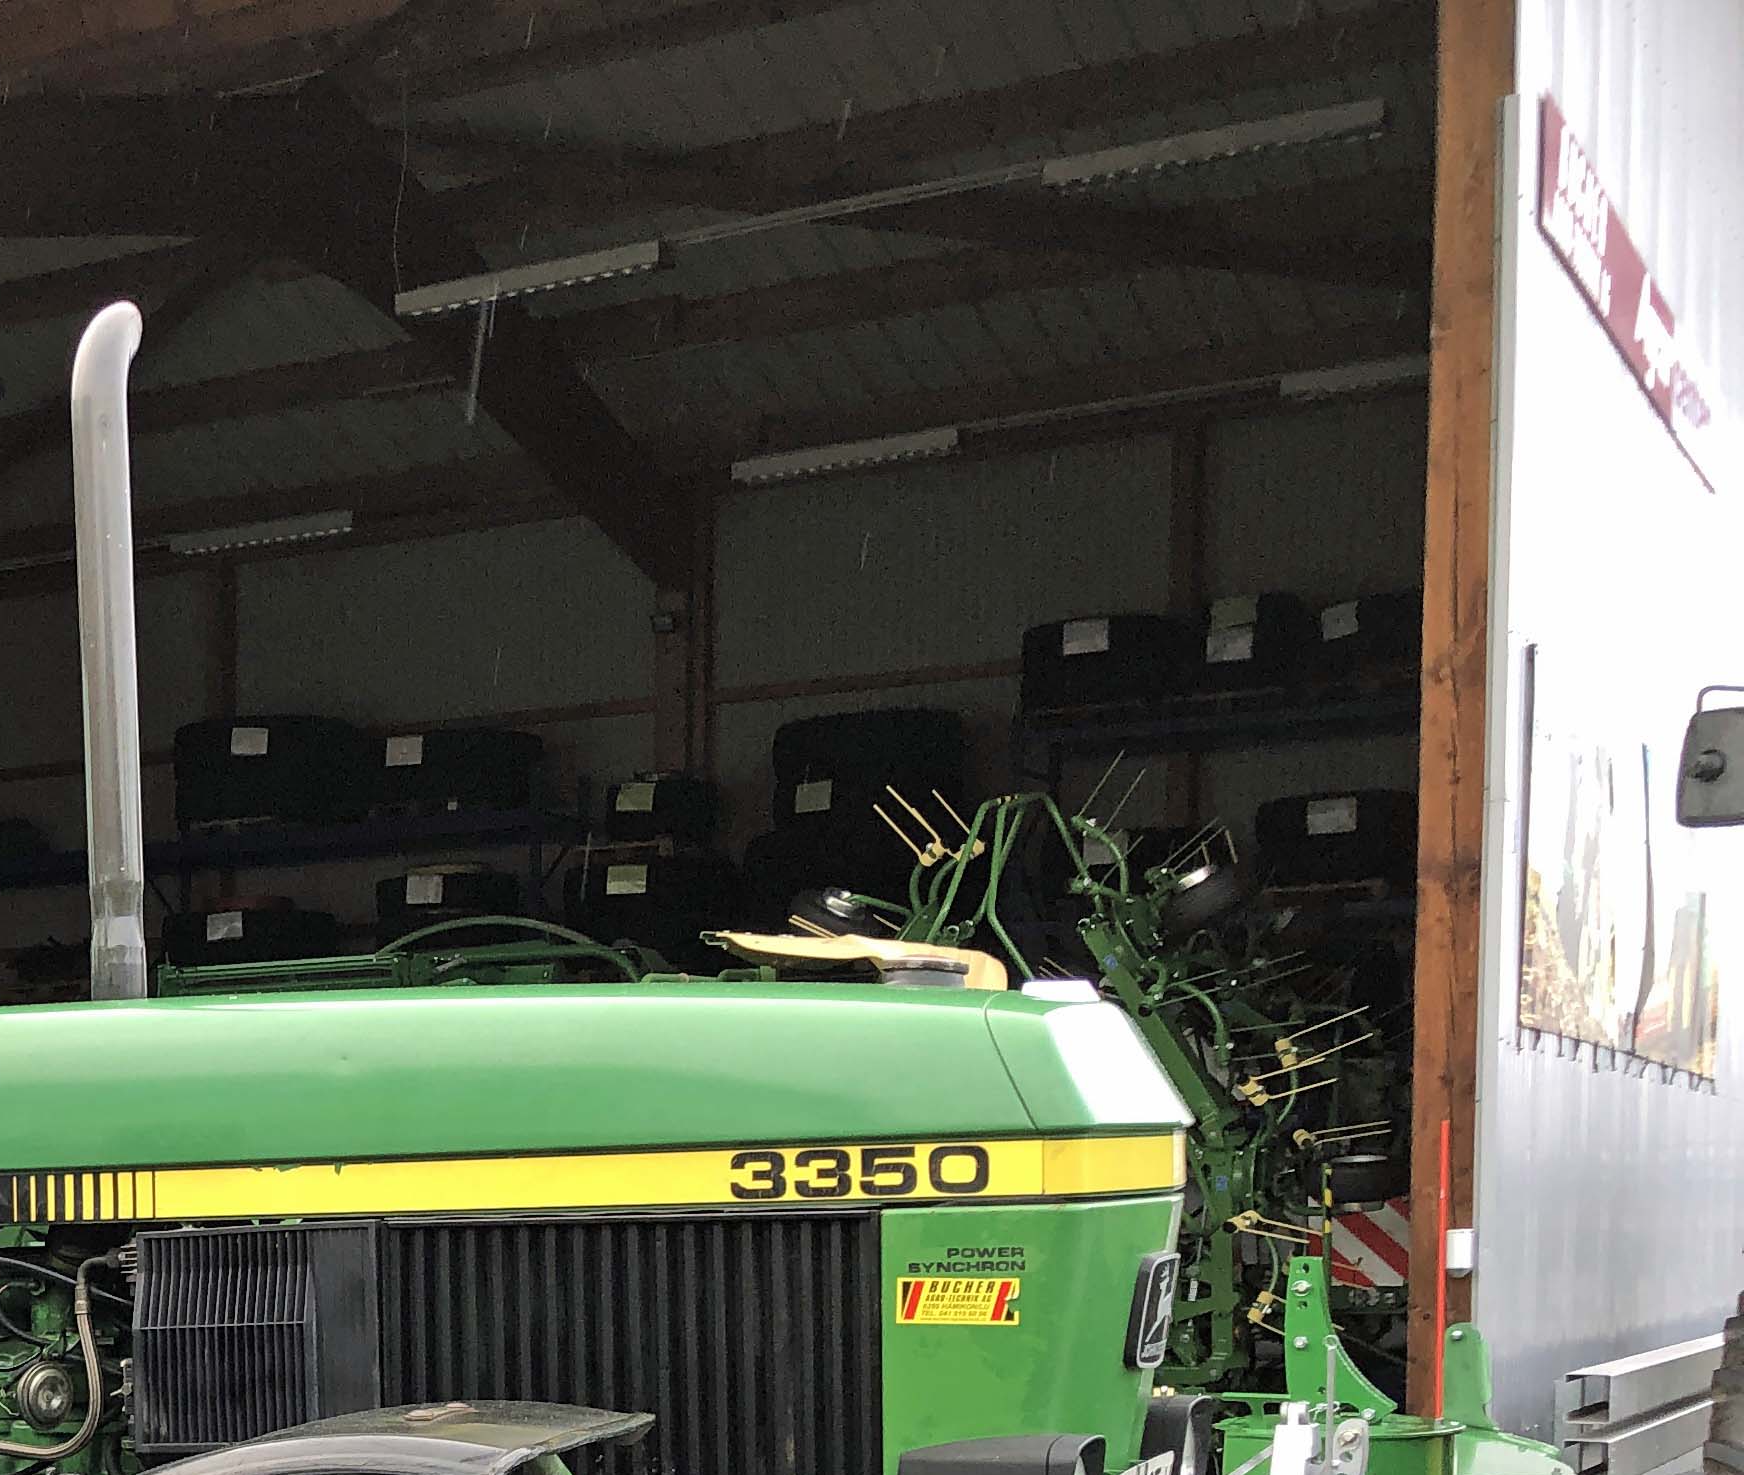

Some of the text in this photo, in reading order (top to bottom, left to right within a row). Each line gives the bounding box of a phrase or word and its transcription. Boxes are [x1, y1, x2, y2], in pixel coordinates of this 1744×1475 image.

[730, 1145, 990, 1200] 3350
[946, 1247, 1025, 1259] POWER
[908, 1260, 1026, 1273] SYNCHRON
[928, 1280, 996, 1294] BUCHER
